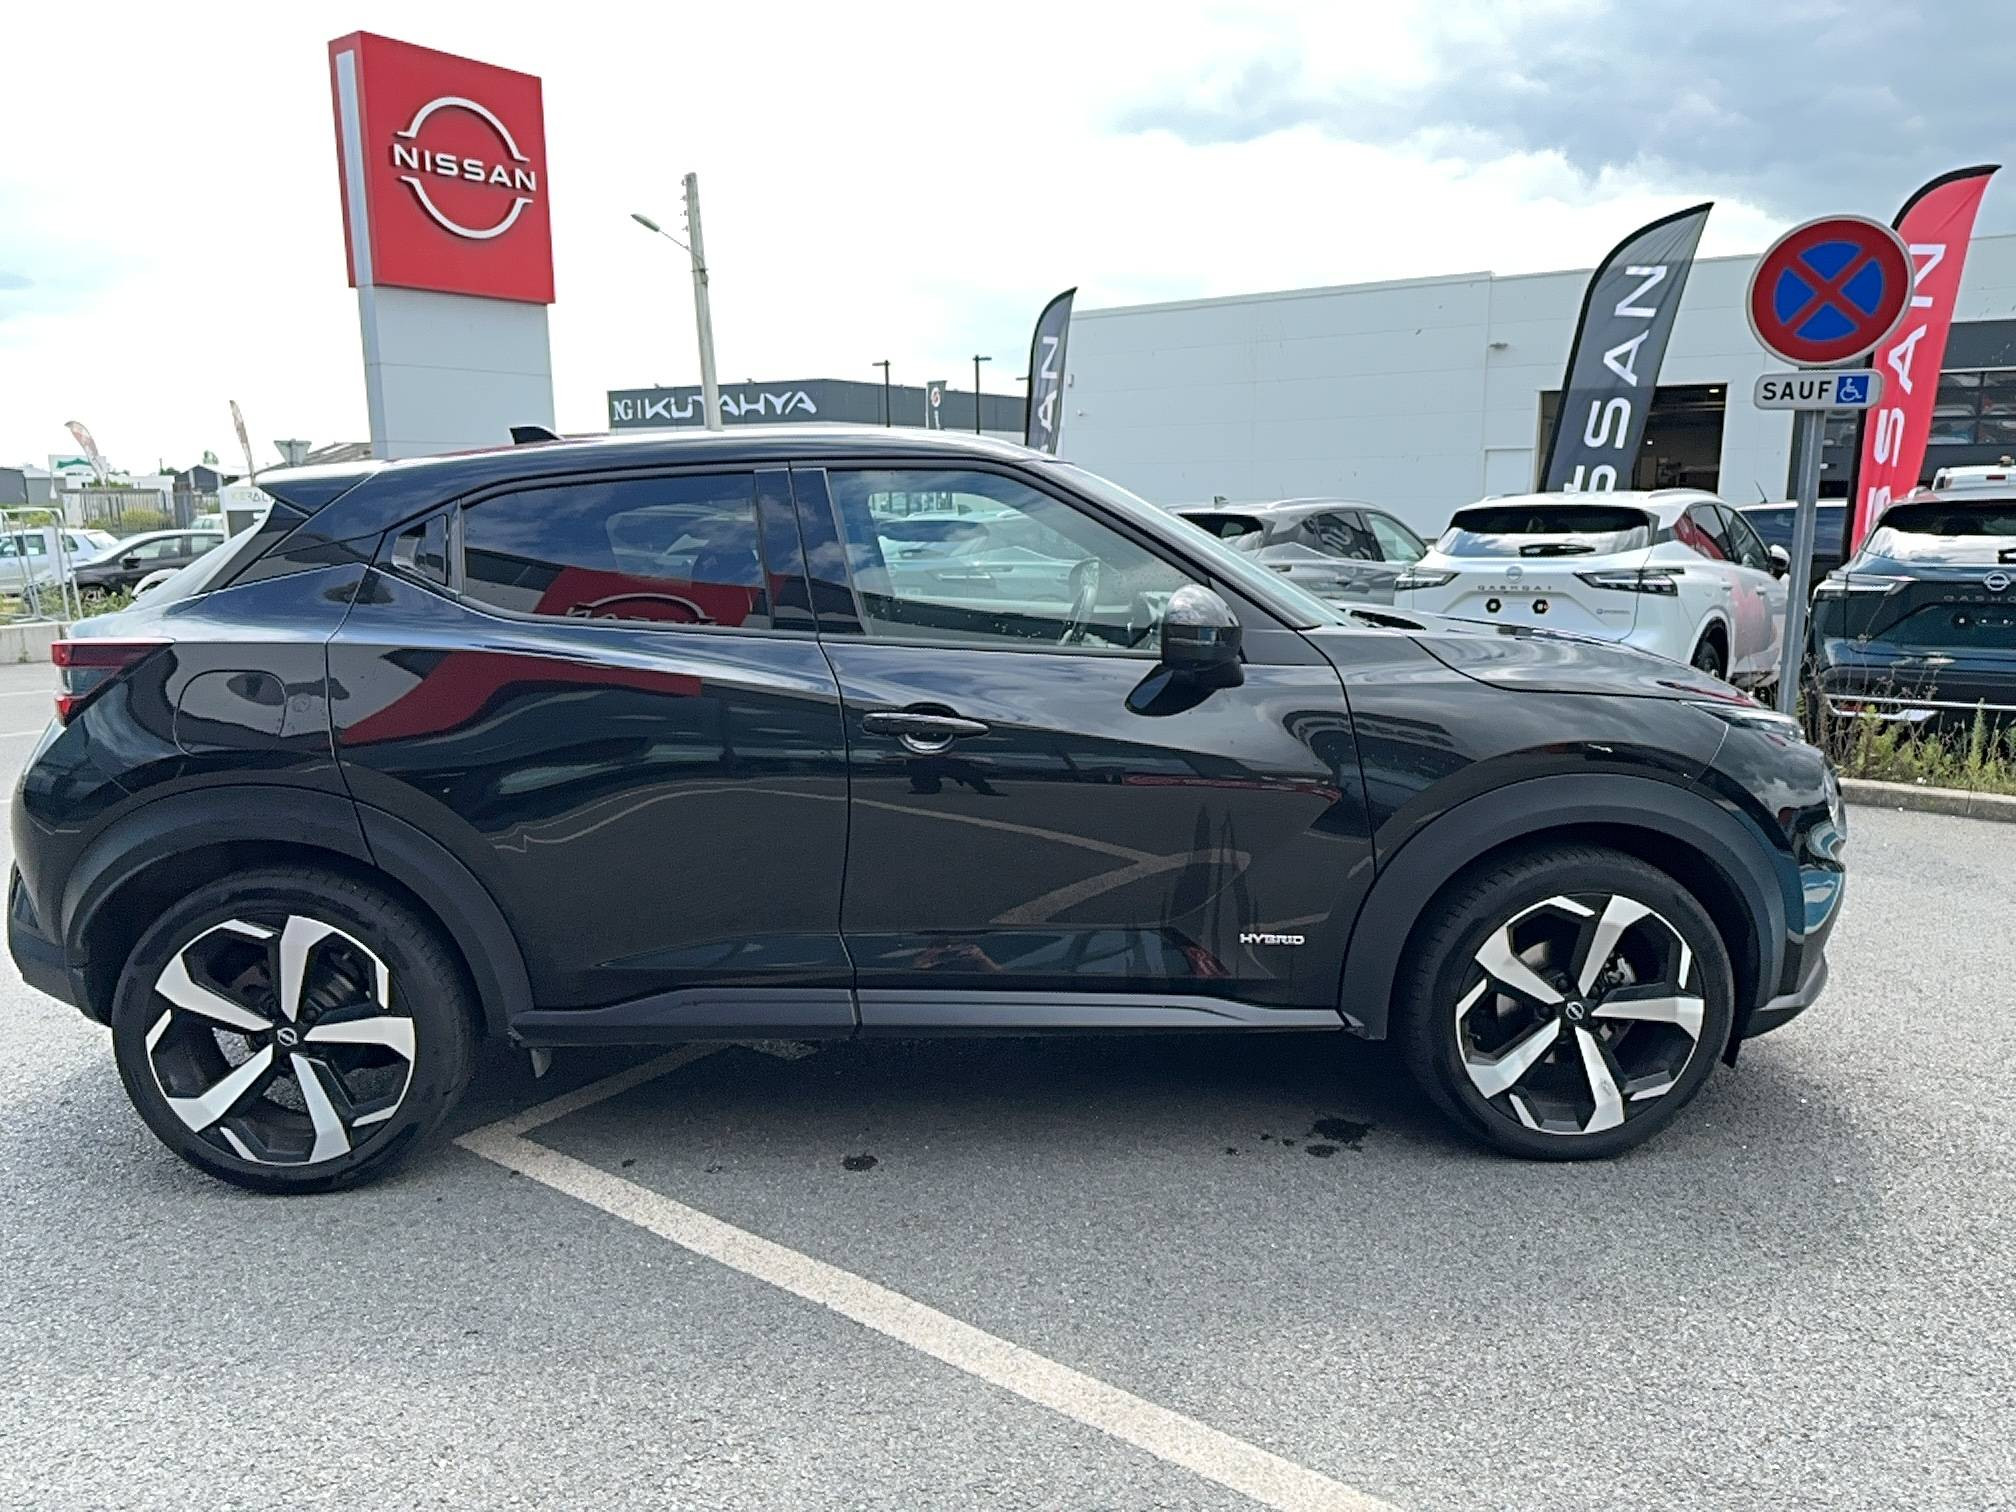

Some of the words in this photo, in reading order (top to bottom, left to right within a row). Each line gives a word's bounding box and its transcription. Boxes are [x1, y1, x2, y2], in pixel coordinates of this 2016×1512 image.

[394, 143, 536, 191] NISSAN
[1038, 336, 1058, 452] AN
[1762, 381, 1832, 401] SAUF
[1240, 933, 1305, 945] HYBRID
